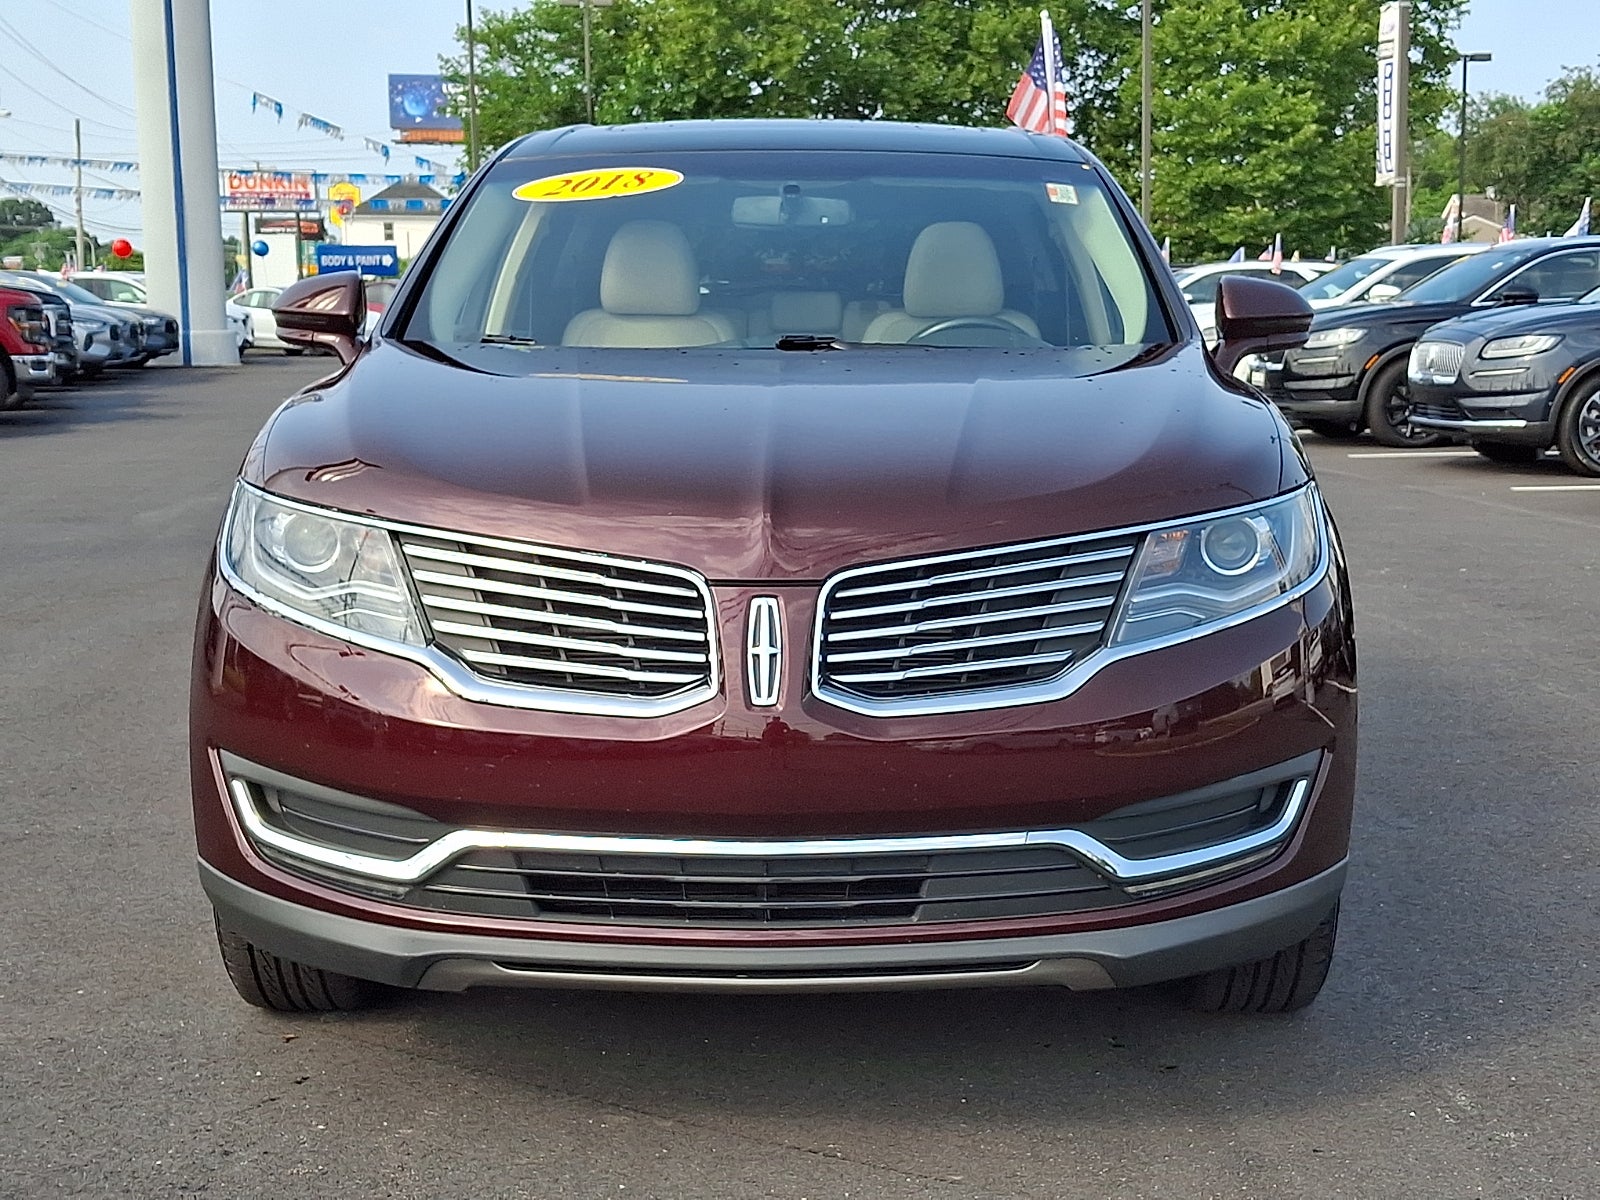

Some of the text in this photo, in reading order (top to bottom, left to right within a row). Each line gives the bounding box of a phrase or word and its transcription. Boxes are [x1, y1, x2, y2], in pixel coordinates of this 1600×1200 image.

[542, 171, 654, 197] 2018
[321, 254, 381, 266] BODY & PAINT
